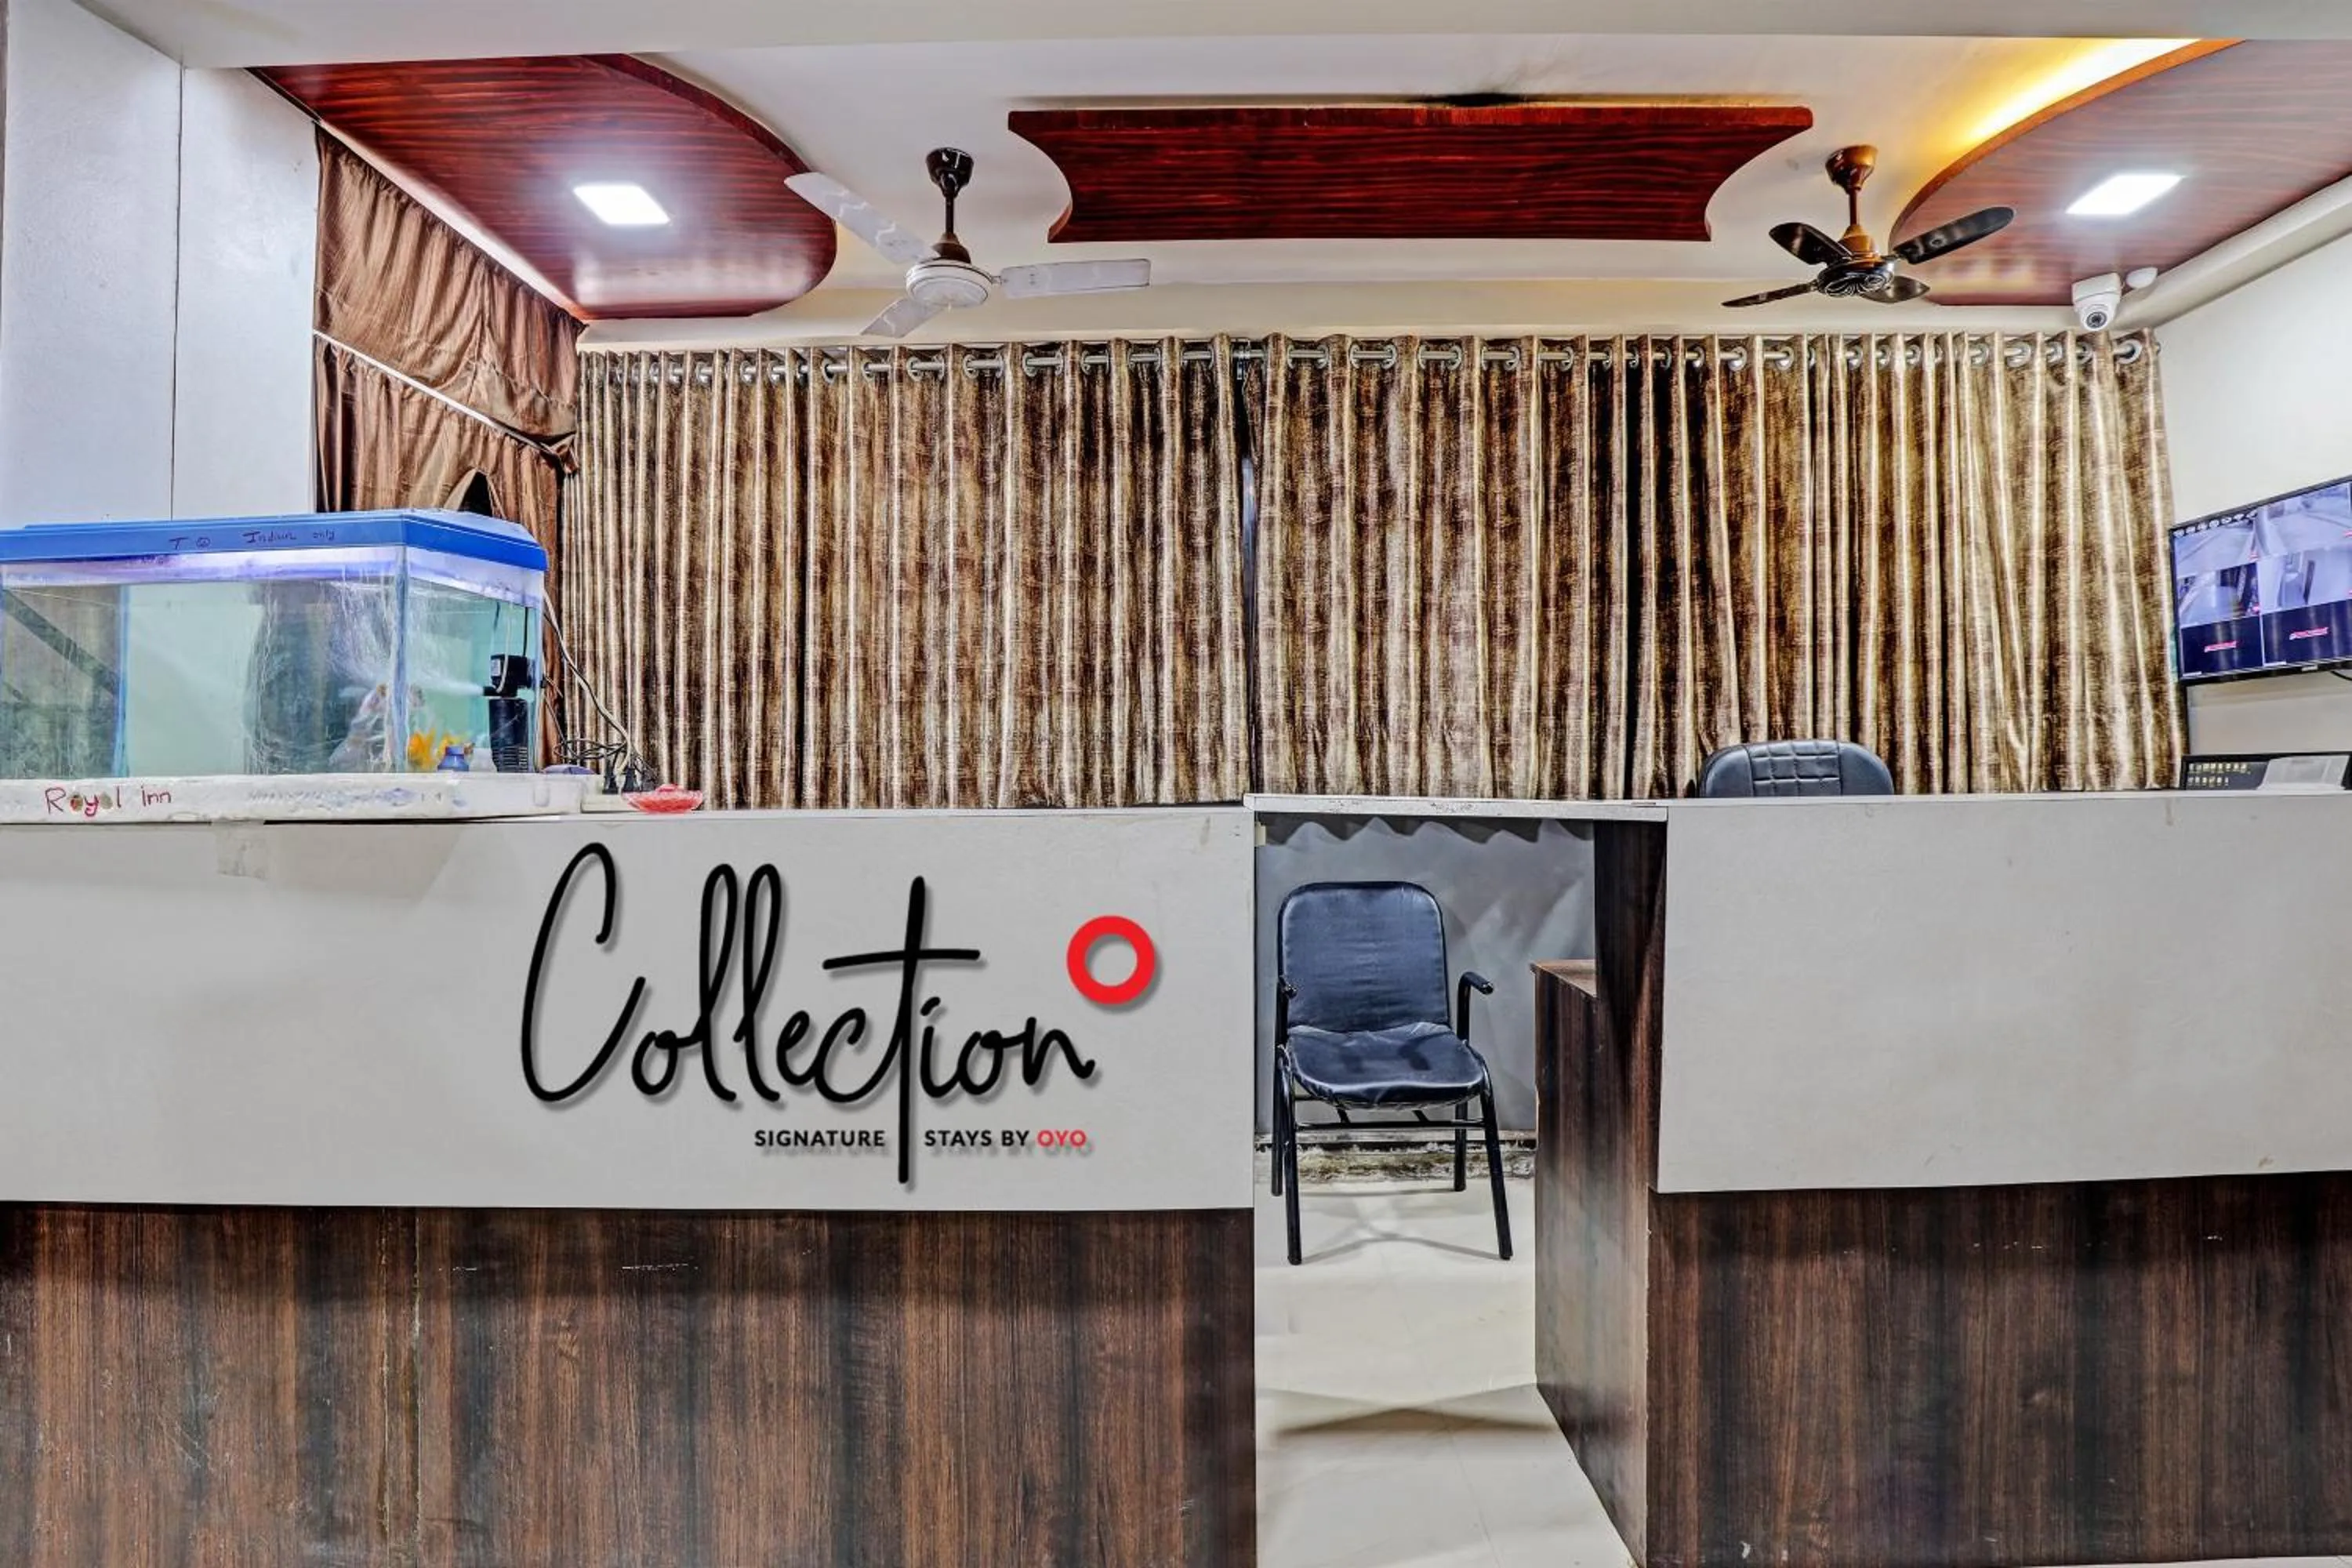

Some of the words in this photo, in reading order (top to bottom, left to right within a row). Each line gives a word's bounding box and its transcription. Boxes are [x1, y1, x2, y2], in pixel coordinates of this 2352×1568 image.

[521, 842, 1096, 1184] Collection
[754, 1129, 885, 1147] SIGNATURE
[924, 1129, 993, 1147] STAYS
[1001, 1130, 1030, 1147] BY
[1036, 1128, 1087, 1148] OYO
